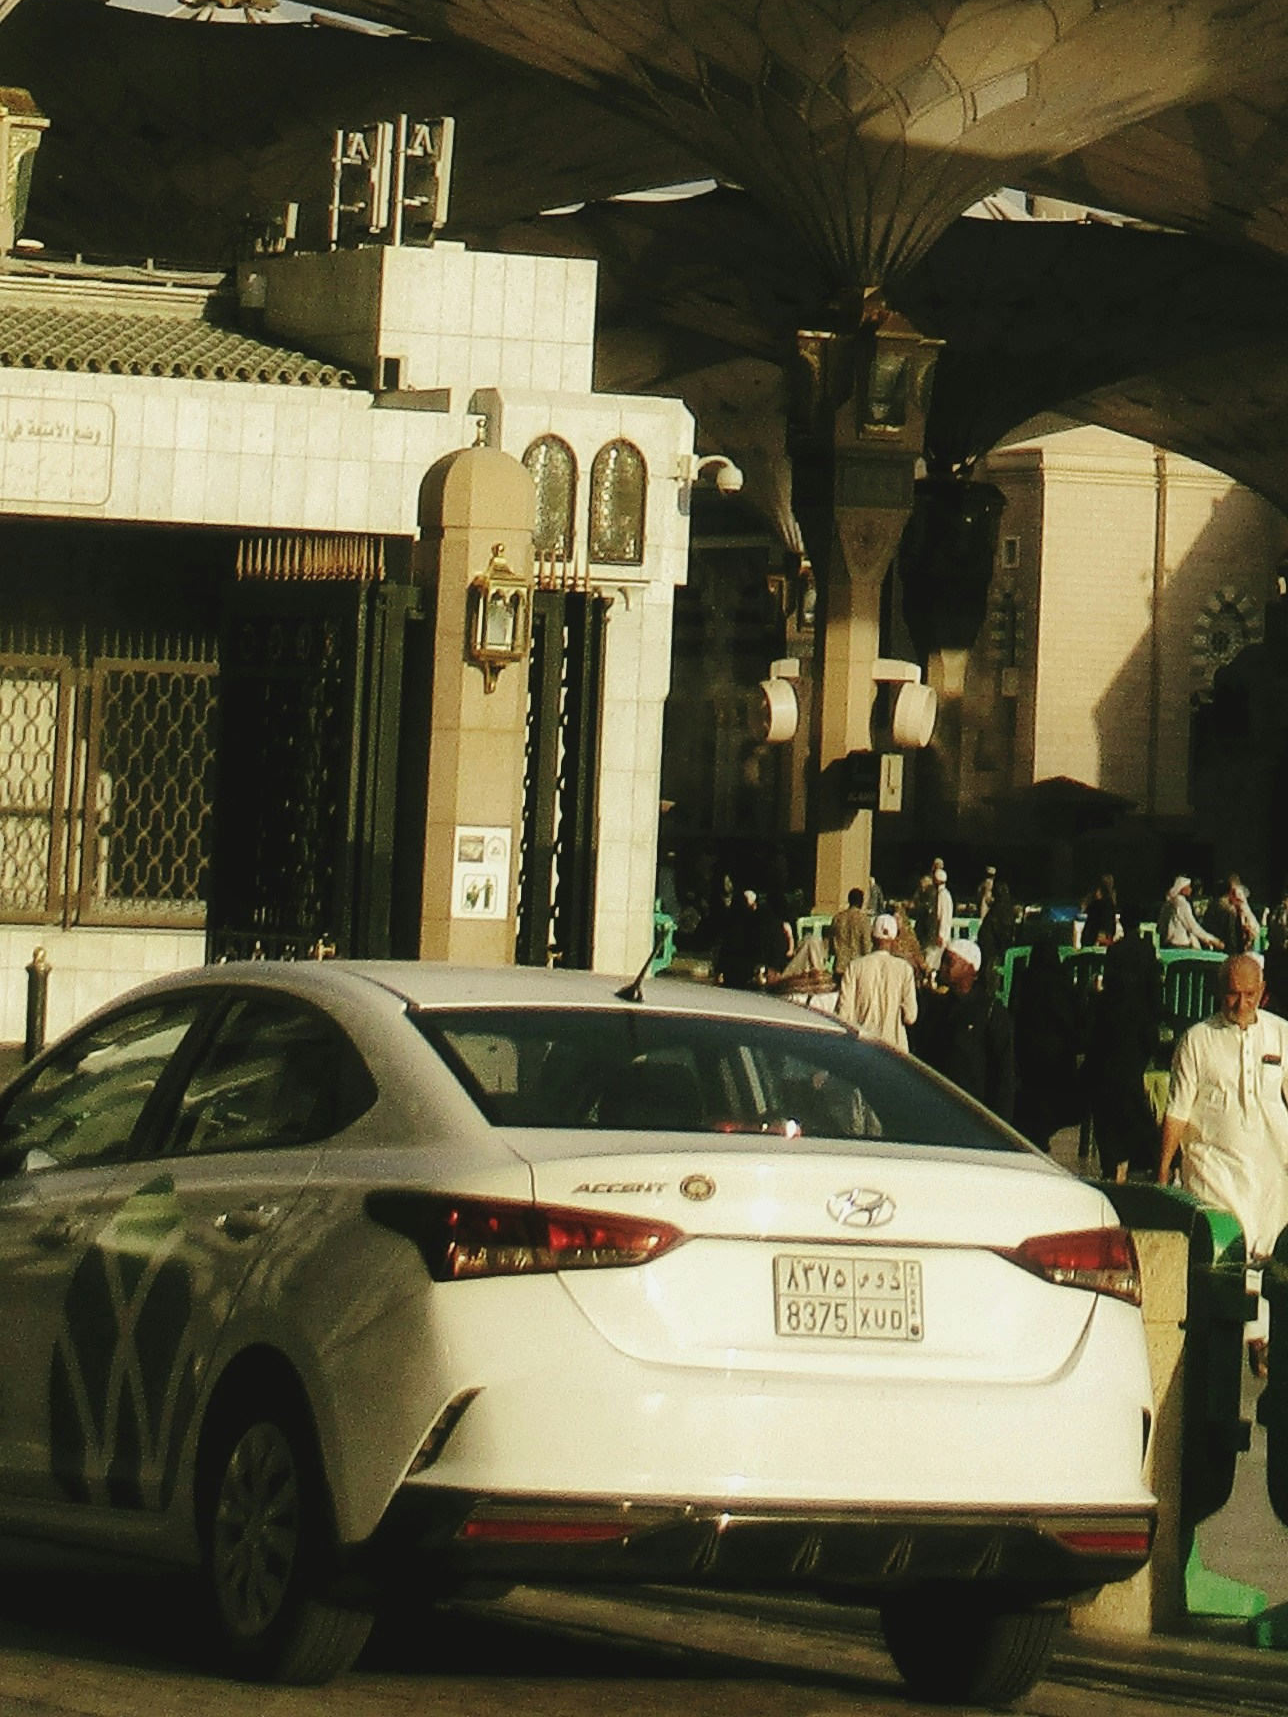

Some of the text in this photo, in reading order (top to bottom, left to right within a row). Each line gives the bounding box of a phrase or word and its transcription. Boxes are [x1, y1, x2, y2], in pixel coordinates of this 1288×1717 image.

[571, 1182, 669, 1194] ACCENT
[787, 1300, 902, 1333] 8375 XUD
